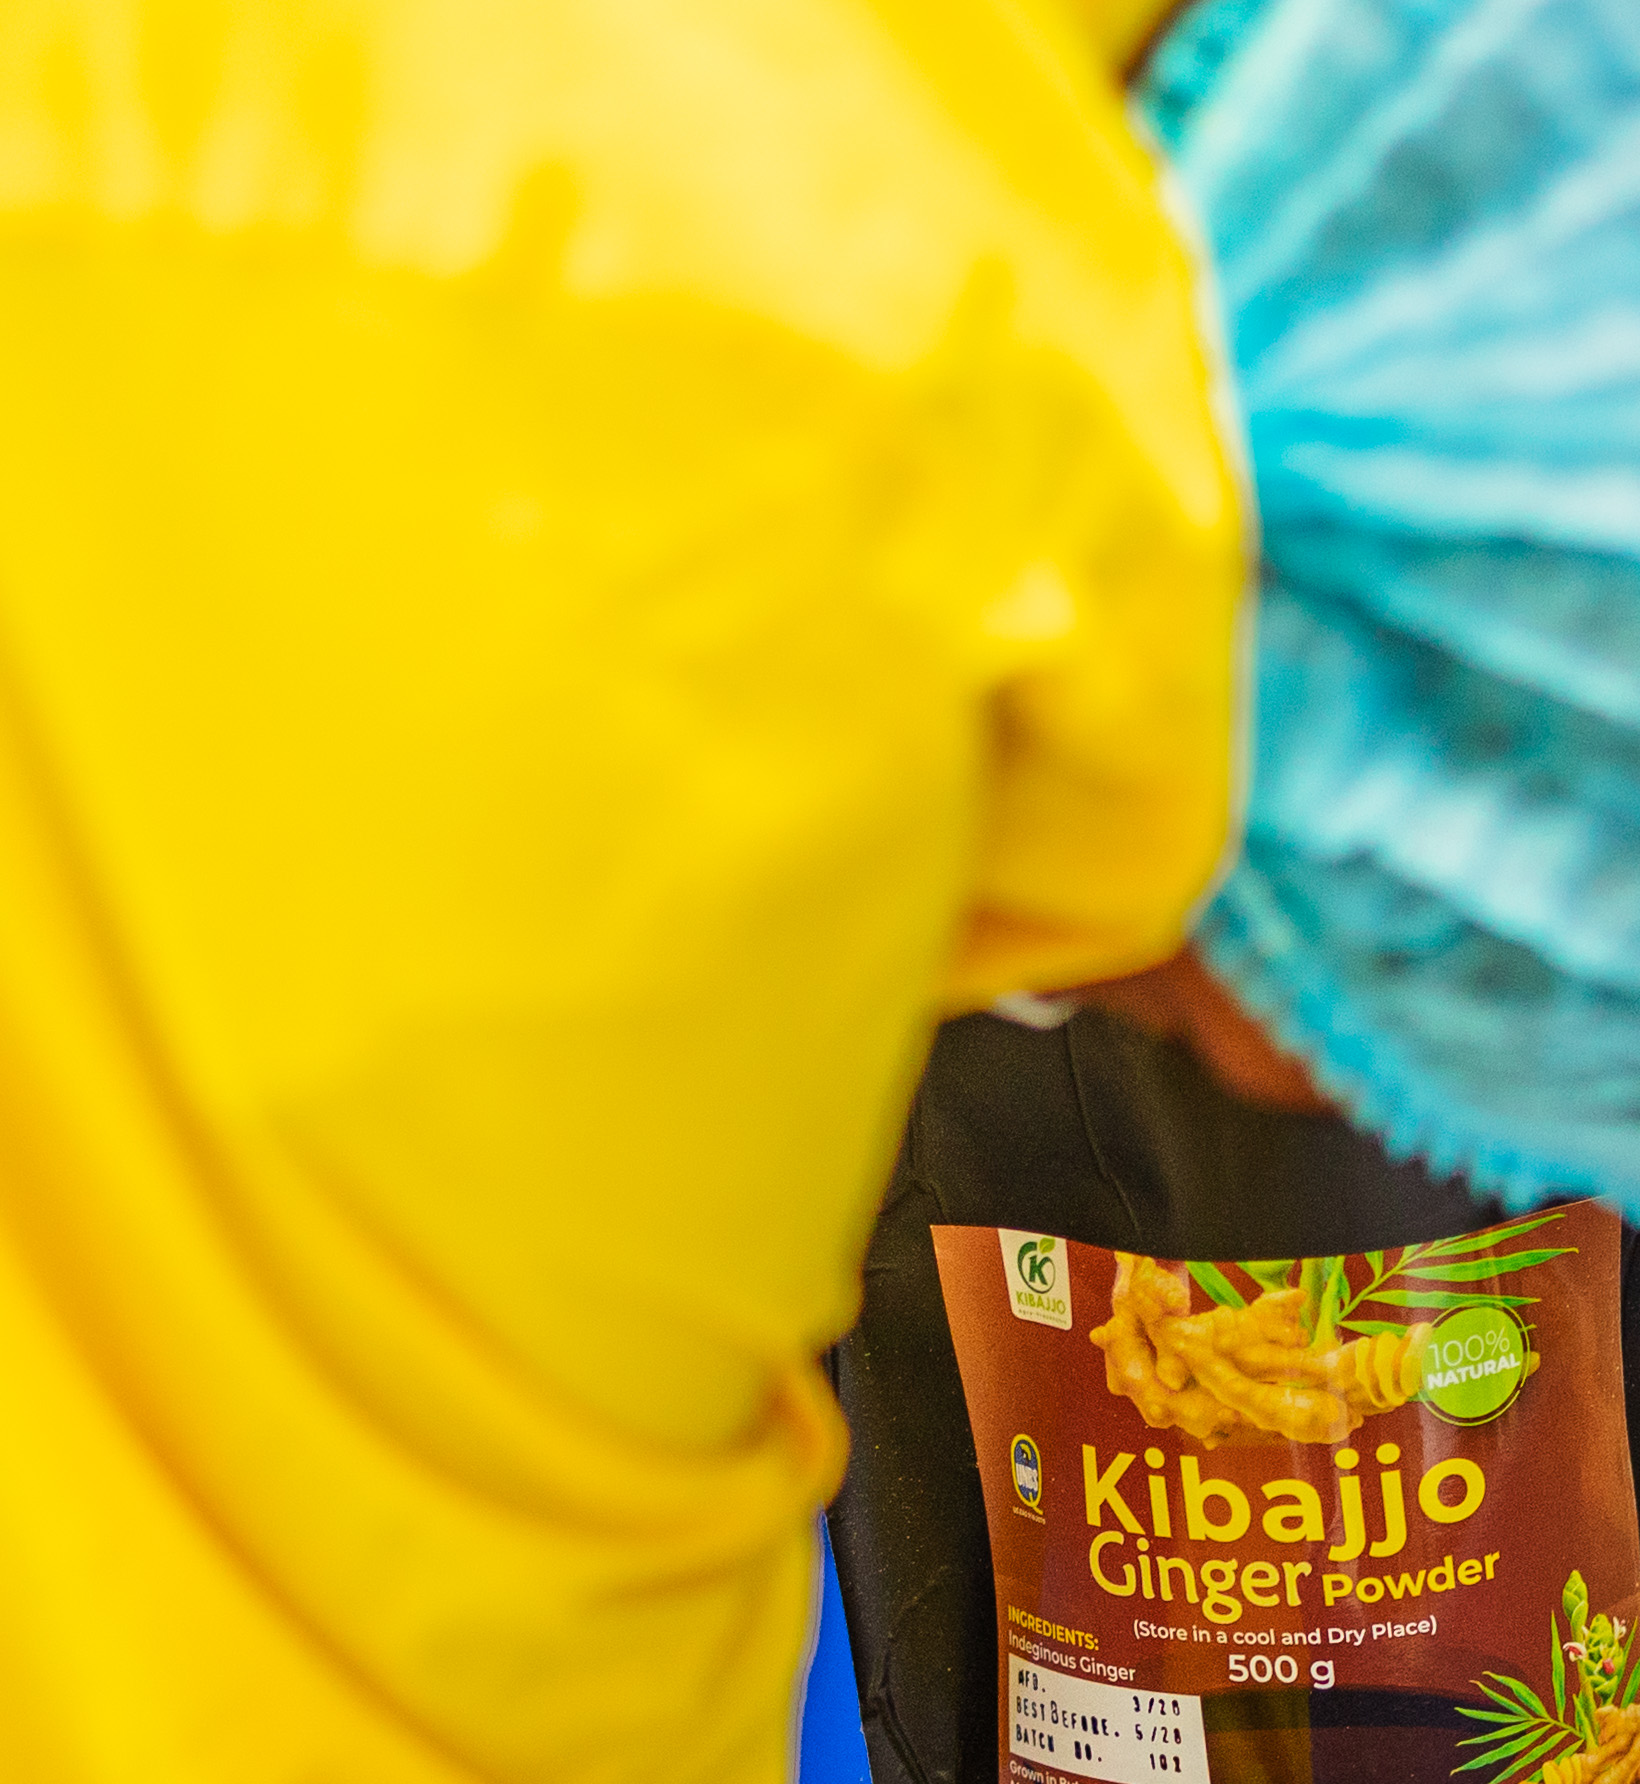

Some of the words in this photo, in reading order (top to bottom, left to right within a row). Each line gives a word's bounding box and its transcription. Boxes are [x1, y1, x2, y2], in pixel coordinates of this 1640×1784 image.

[1016, 1290, 1066, 1314] KIBAJJO
[1428, 1327, 1510, 1370] 100%
[1427, 1353, 1520, 1390] NATURAL
[1081, 1443, 1486, 1562] Kibajjo
[1089, 1530, 1313, 1624] Ginger
[1322, 1551, 1500, 1606] Powder
[1008, 1605, 1099, 1651] INGREDIENTS:
[1134, 1619, 1188, 1640] (Store
[1192, 1625, 1211, 1643] in
[1216, 1631, 1227, 1644] a
[1233, 1628, 1275, 1645] cool
[1281, 1627, 1321, 1645] and
[1327, 1627, 1366, 1646] Dry
[1372, 1614, 1437, 1640] Place)
[1009, 1629, 1076, 1669] Indeginous
[1079, 1657, 1136, 1682] Ginger
[1228, 1654, 1298, 1684] 500
[1310, 1660, 1335, 1689] g
[1010, 1760, 1044, 1784] Grown
